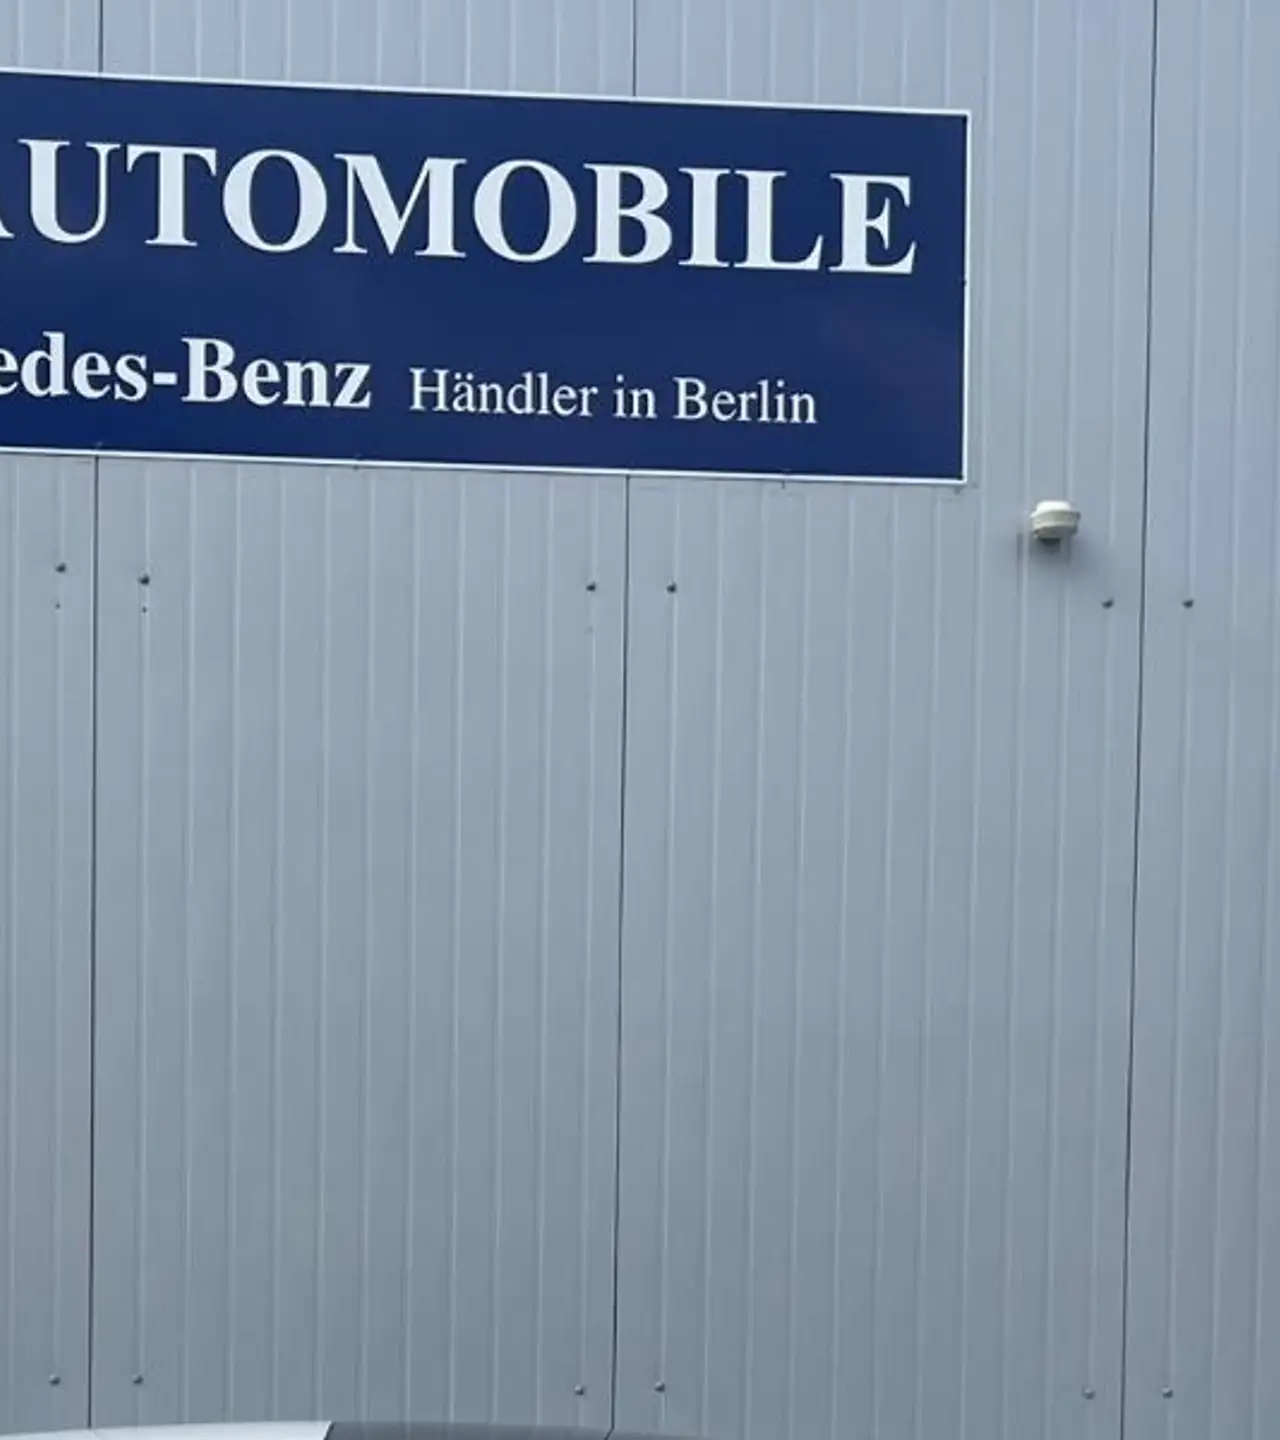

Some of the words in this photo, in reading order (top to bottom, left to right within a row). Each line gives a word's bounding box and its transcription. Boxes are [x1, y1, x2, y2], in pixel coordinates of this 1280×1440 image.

[410, 365, 598, 417] Händler
[613, 374, 656, 420] in
[673, 376, 818, 424] Berlin
